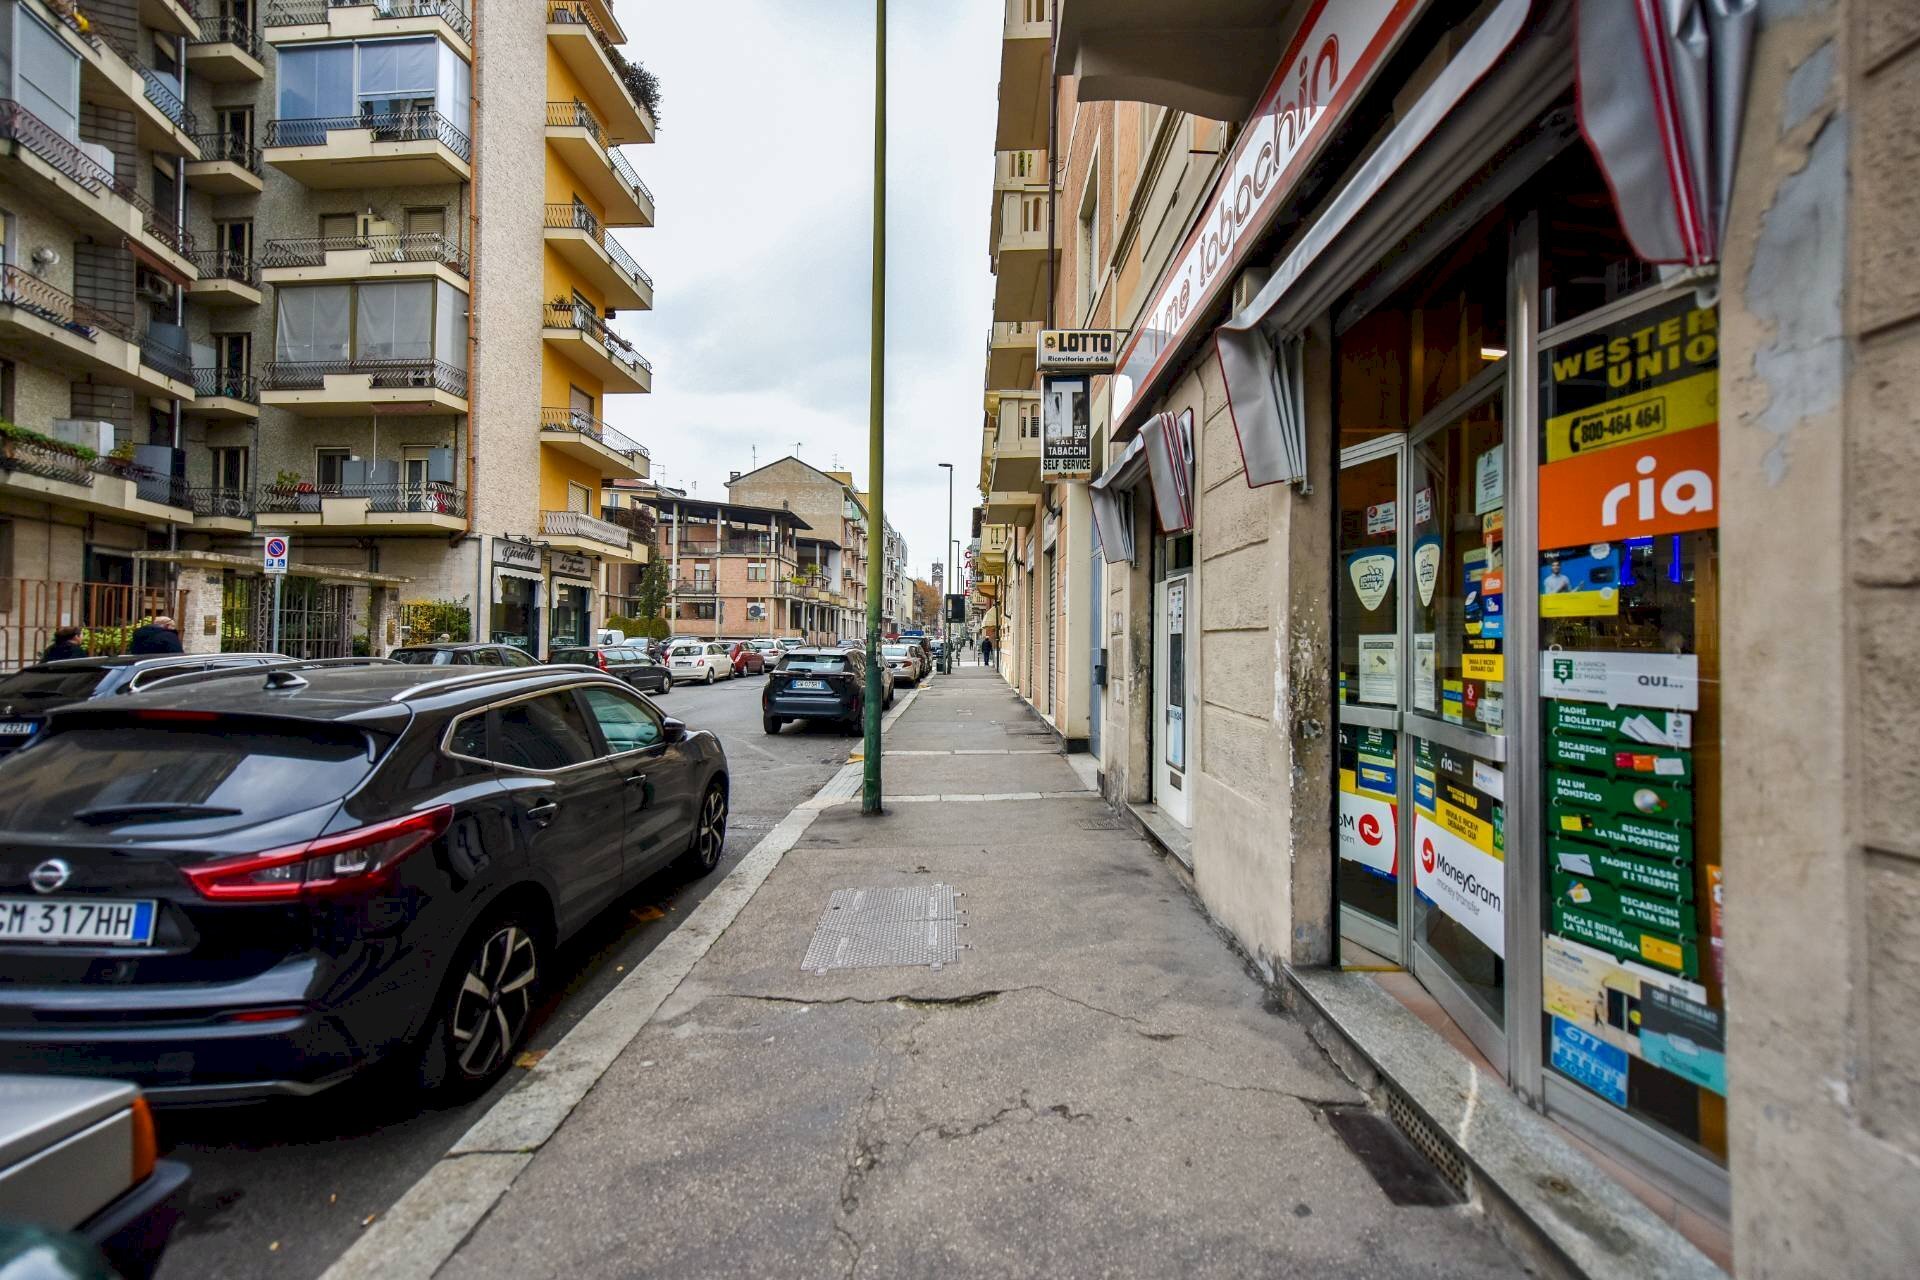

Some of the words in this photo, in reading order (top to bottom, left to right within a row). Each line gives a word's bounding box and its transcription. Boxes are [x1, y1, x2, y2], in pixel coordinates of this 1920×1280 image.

[1058, 333, 1112, 352] LOTTO
[1095, 354, 1109, 362] 646
[1052, 381, 1084, 437] T
[1581, 413, 1632, 444] 800-464
[1635, 404, 1661, 428] 464
[1047, 446, 1087, 456] TABACCHI
[1043, 460, 1060, 470] SELF
[1062, 460, 1091, 470] SERVICE
[1602, 456, 1713, 527] ria
[1558, 665, 1568, 679] 5
[1559, 705, 1587, 716] PAGHI
[1565, 716, 1617, 729] BOLLETTINI
[1558, 741, 1607, 756] RICARICHI
[1558, 750, 1585, 761] CARTE
[1440, 752, 1453, 772] ria
[1557, 778, 1571, 788] FAI
[1572, 780, 1586, 789] UN
[1557, 787, 1602, 802] BONIFICO
[1594, 828, 1607, 838] LA
[1608, 831, 1627, 843] TUA
[1627, 835, 1681, 853] POSTEPAY
[1621, 823, 1680, 843] RICARICHI
[1600, 855, 1633, 870] PAGHI
[1633, 862, 1645, 873] LE
[1647, 865, 1679, 882] TASSE
[1436, 853, 1502, 912] MoneyGram
[1637, 874, 1680, 893] TRIBUTI
[1620, 895, 1680, 918] RICARICHI
[37, 904, 133, 936] 317HH
[1563, 911, 1586, 926] PAGA
[1594, 921, 1625, 939] RITIRA
[1622, 906, 1636, 917] LA
[1637, 909, 1657, 923] TUA
[1658, 914, 1681, 929] SIM
[1563, 920, 1575, 931] LA
[1576, 924, 1594, 938] TUA
[1594, 930, 1611, 944] SIM
[1612, 936, 1640, 953] KENA
[1564, 1026, 1602, 1052] GTT
